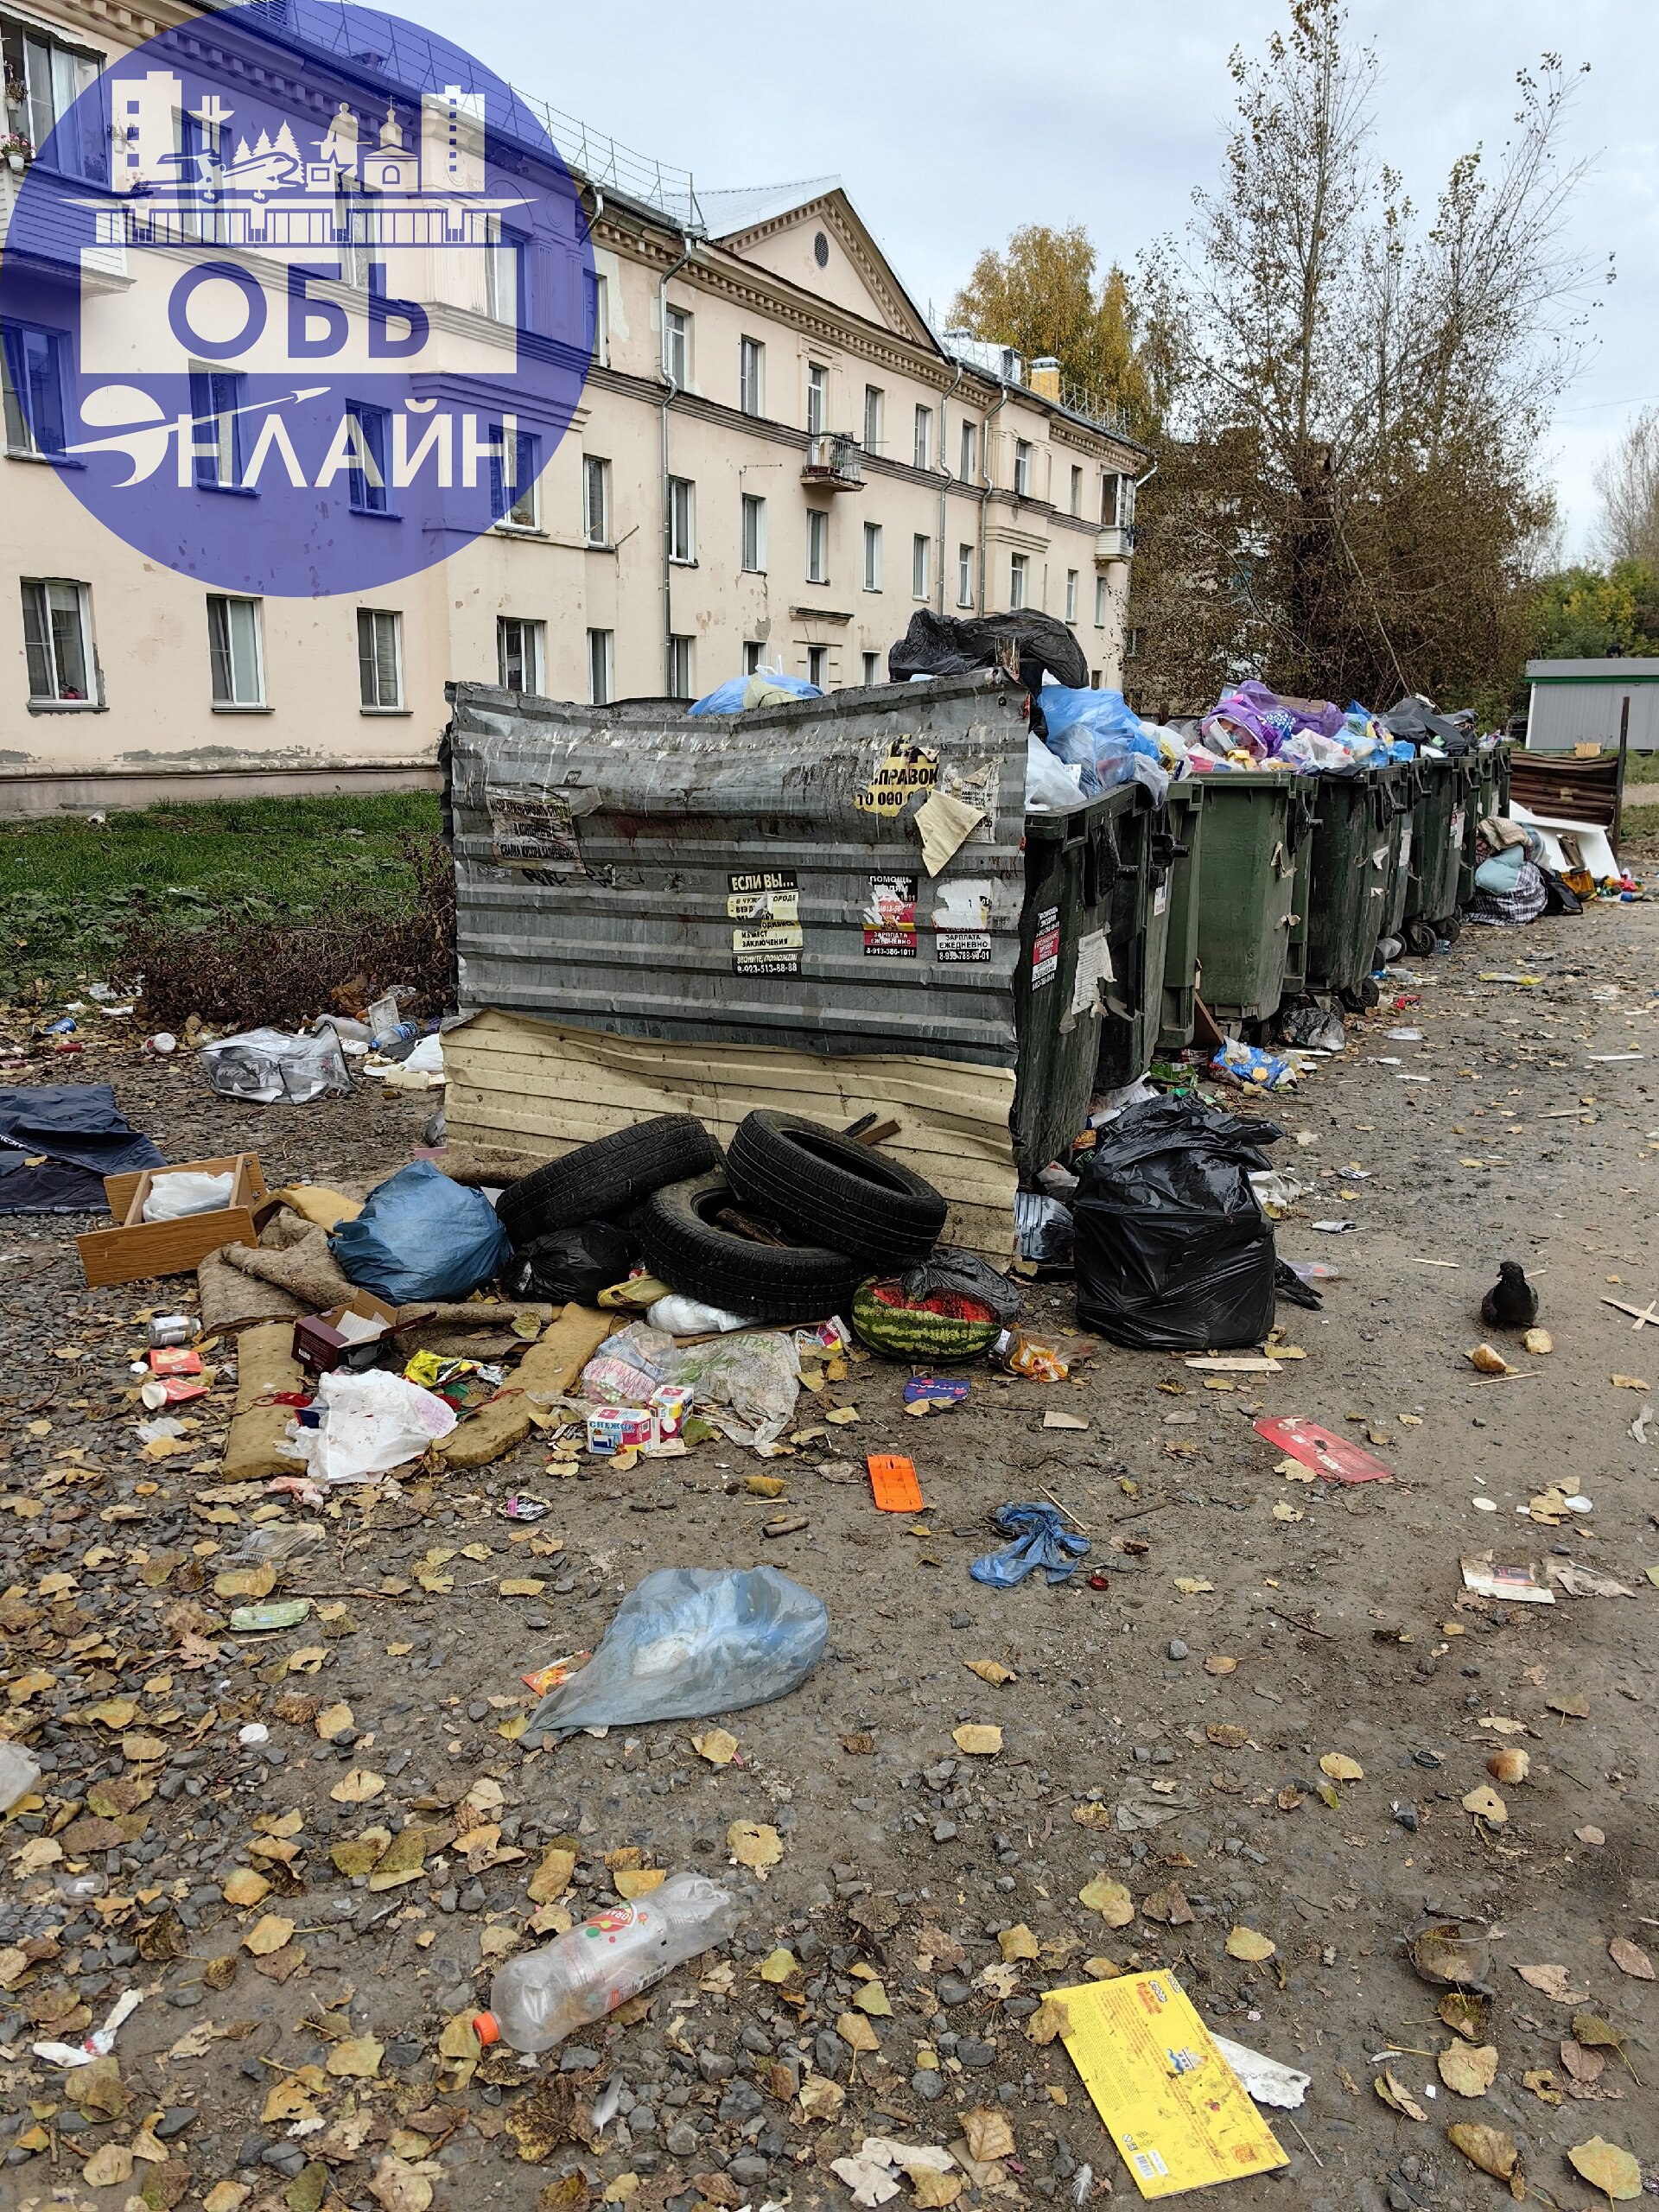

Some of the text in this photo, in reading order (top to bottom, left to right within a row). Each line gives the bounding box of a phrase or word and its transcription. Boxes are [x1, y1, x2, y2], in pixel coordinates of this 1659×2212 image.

[872, 768, 938, 786] ПРАВОК
[877, 792, 903, 806] 000
[731, 873, 794, 891] ЕСЛИ ВЫ...
[869, 875, 912, 884] ПОМОЩЬ
[742, 938, 788, 948] ЗАКЛЮЧЕНИЯ
[939, 941, 988, 950] ЕЖЕДНЕВНО
[866, 947, 914, 956] 8-913-386-1011
[736, 954, 764, 964] ЗВОНИТЕ,
[737, 963, 798, 974] 8-923-513-88-88
[589, 1421, 636, 1431] СНЕЖОК
